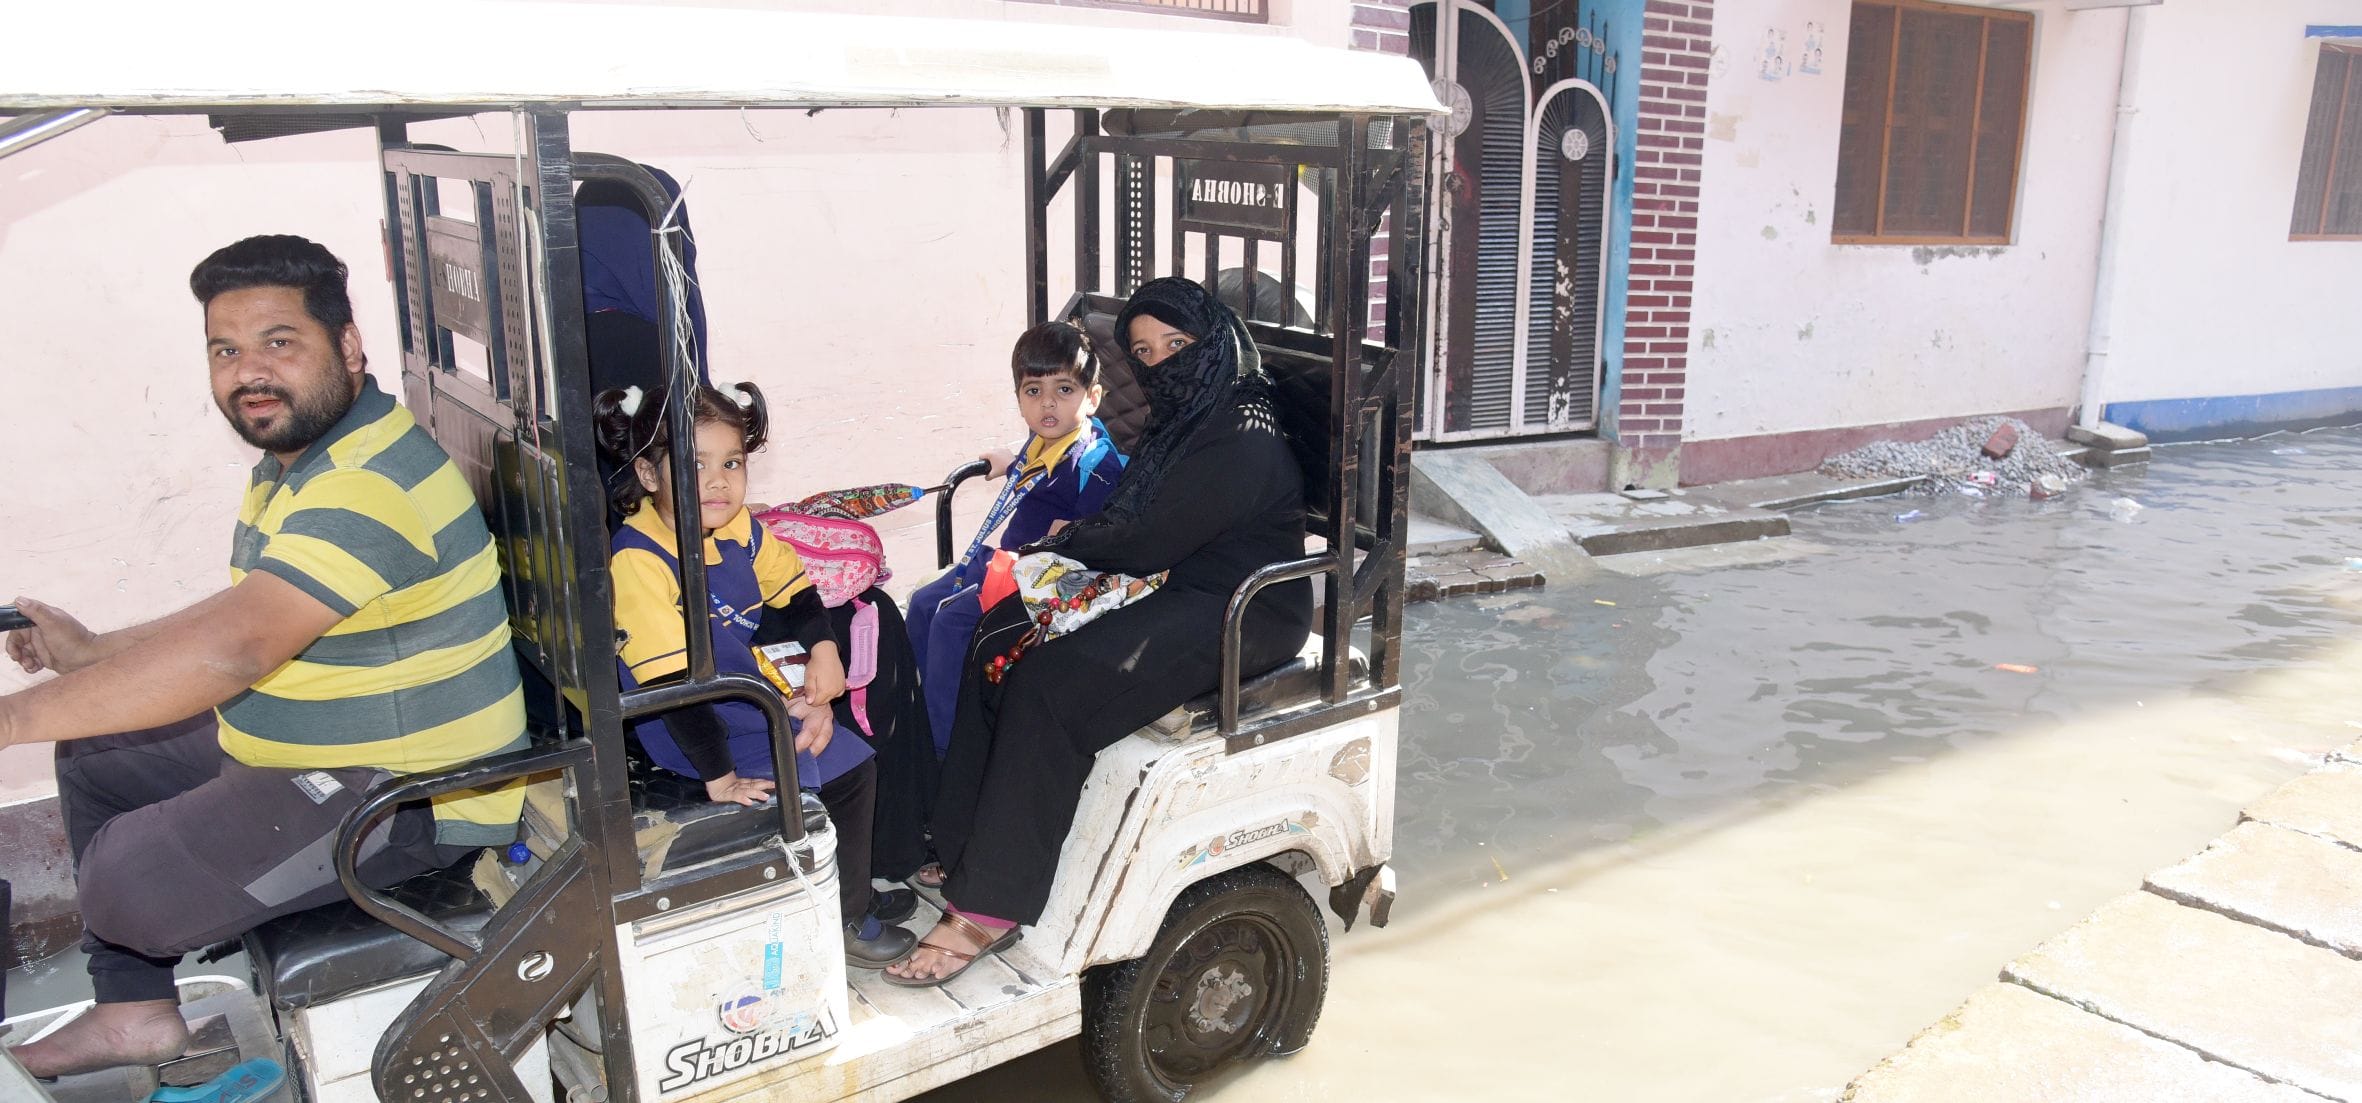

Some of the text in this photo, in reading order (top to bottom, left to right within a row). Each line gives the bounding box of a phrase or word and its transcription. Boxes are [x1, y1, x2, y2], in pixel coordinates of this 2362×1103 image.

[976, 519, 992, 543] JULIUS
[989, 501, 1002, 518] HIGH
[1000, 473, 1018, 500] SCHOOL
[1004, 492, 1026, 514] SCHOOL
[1225, 818, 1289, 850] SHOBHA
